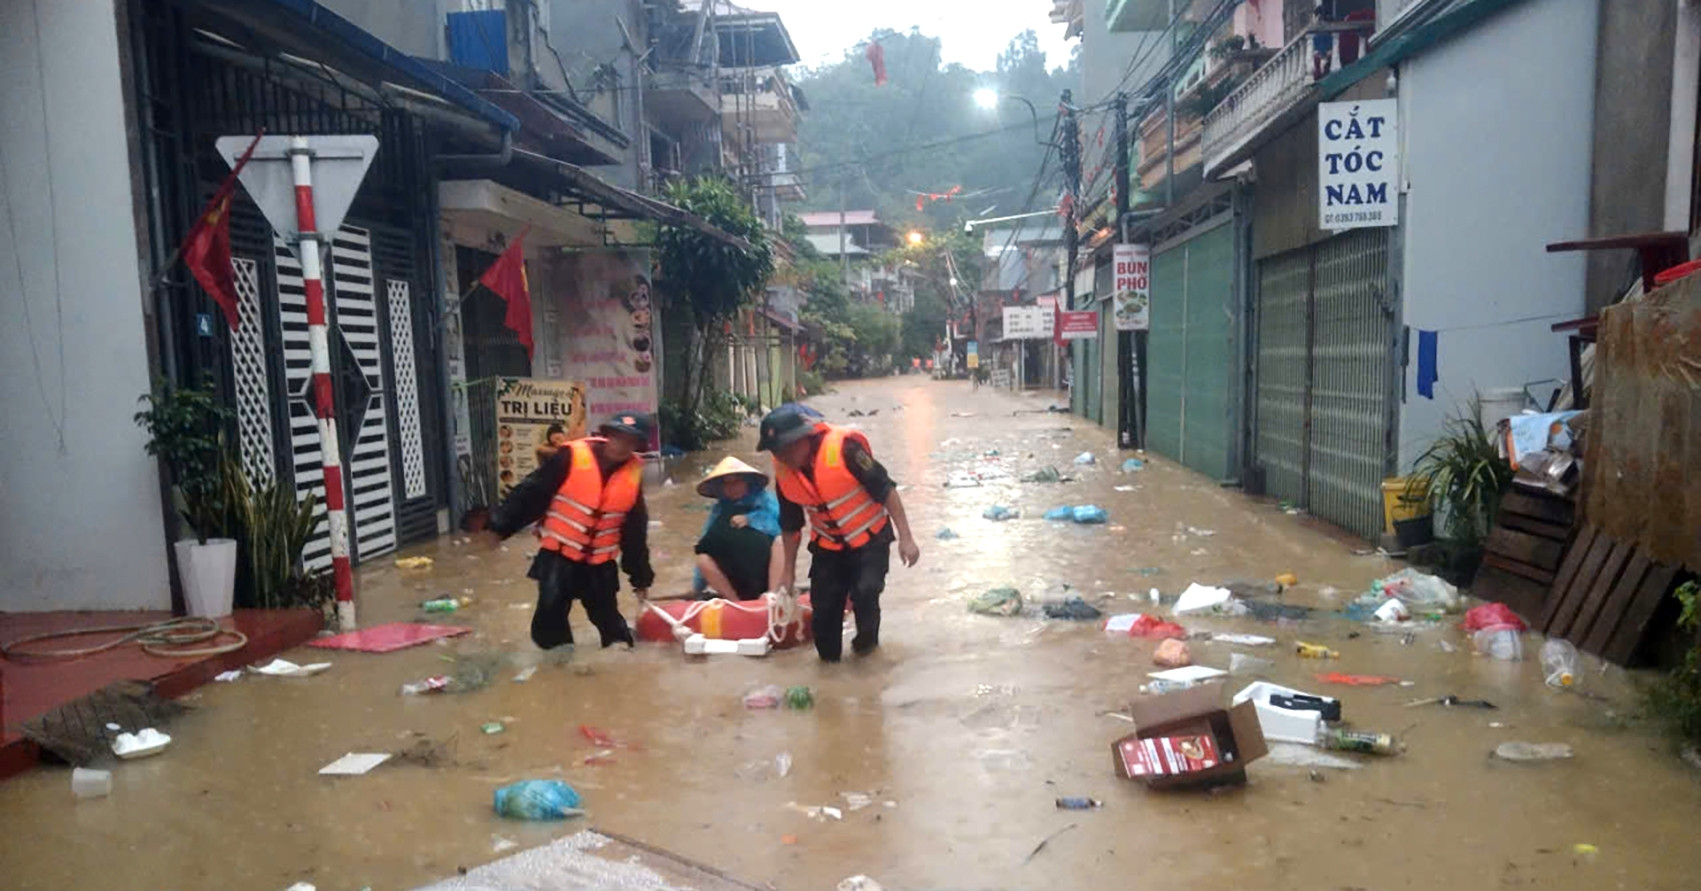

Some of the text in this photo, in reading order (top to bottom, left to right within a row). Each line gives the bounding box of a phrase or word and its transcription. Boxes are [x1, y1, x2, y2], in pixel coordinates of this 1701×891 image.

[1325, 105, 1385, 140] CẮT
[1325, 145, 1383, 174] TÓC
[1325, 182, 1387, 206] NAM
[501, 401, 528, 418] TRỊ
[534, 398, 572, 419] LIỆU
